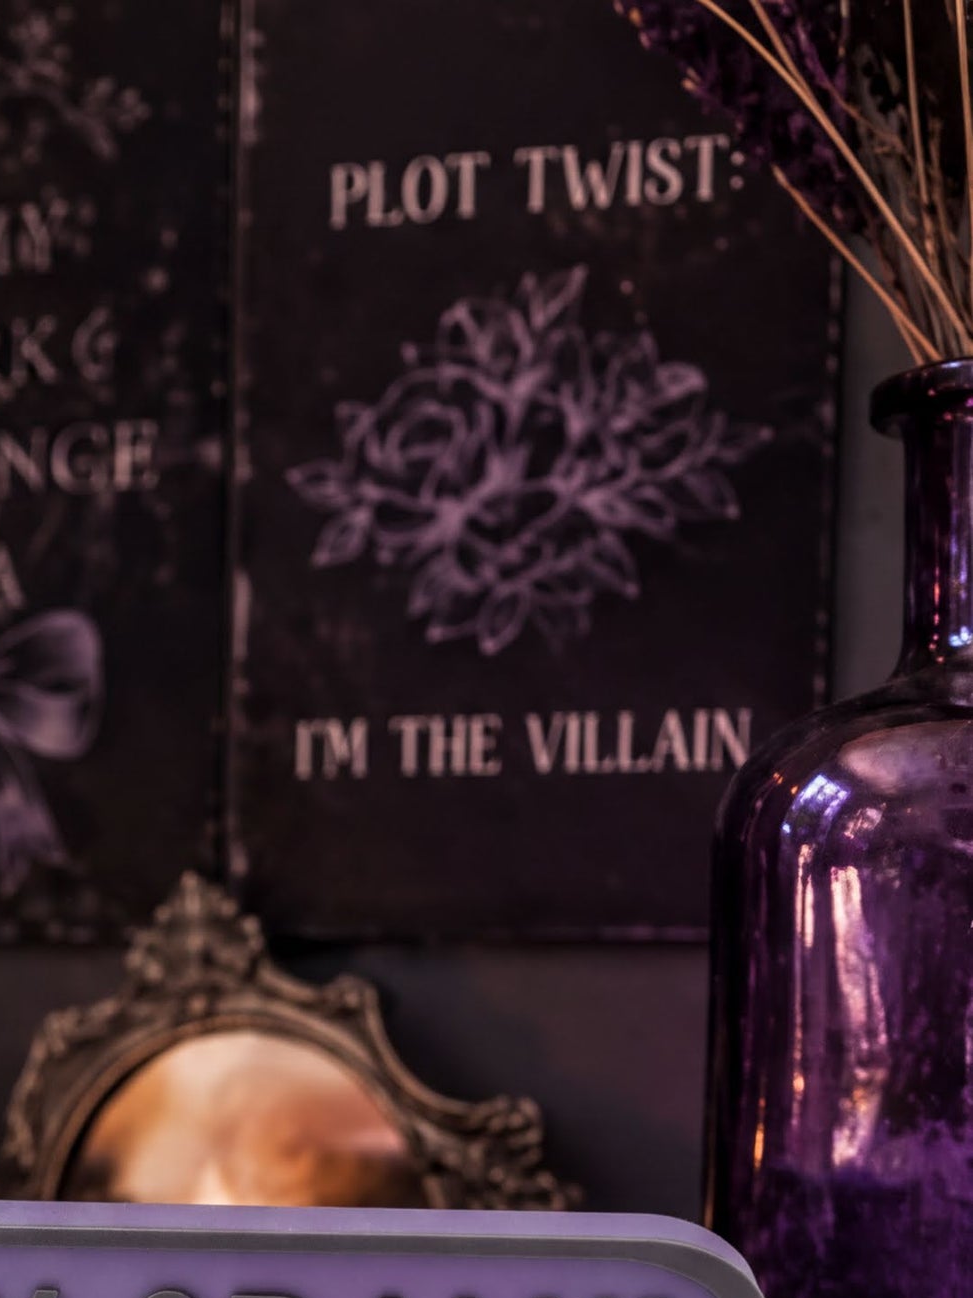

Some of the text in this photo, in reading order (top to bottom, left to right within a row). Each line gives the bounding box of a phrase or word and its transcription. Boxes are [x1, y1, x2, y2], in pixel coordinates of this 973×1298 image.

[330, 133, 744, 229] PLOT TWIST:
[295, 708, 753, 779] I'M THE VILLAIN
